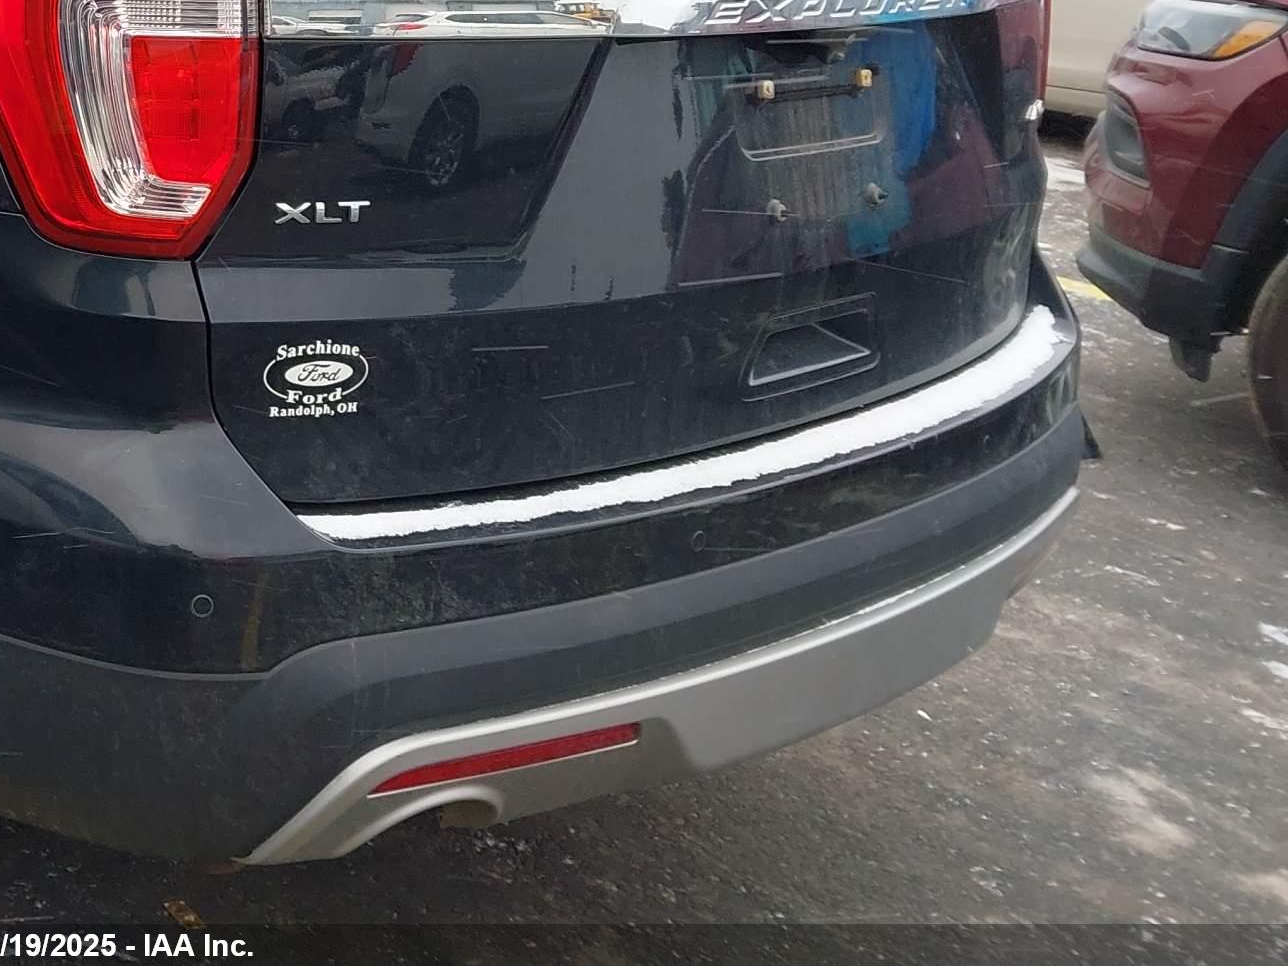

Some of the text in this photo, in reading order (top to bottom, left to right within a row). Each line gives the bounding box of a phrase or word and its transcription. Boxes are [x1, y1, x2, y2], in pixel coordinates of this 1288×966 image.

[274, 200, 371, 224] XLT
[276, 339, 360, 361] Sarchione
[297, 363, 342, 382] Ford
[286, 387, 342, 404] Ford
[269, 401, 358, 418] Randolph, OH
